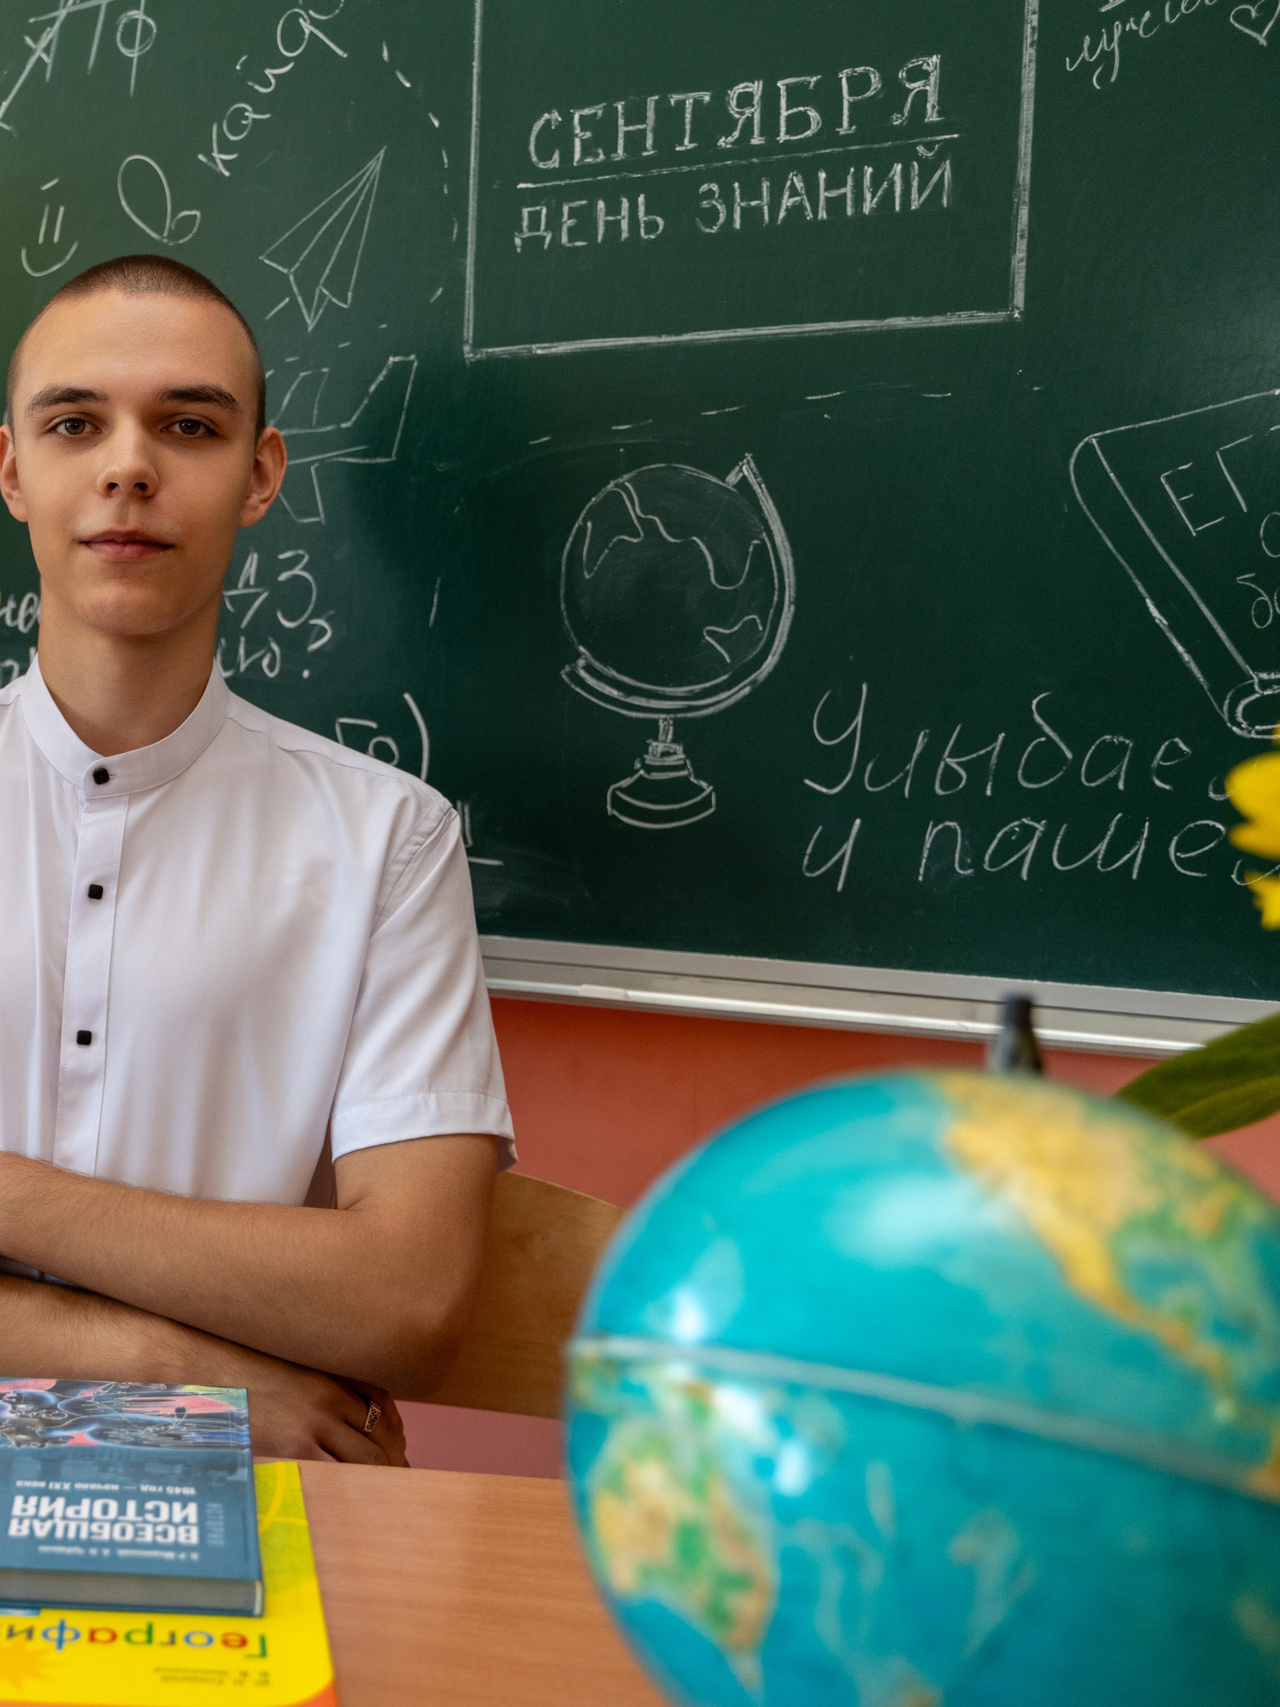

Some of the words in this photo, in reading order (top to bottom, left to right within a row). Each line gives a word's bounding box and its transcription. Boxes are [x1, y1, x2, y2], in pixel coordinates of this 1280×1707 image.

[527, 54, 942, 169] СЕНТЯБРЯ
[514, 193, 665, 253] ДЕНЬ
[694, 142, 953, 236] ЗНАНИЙ
[1160, 424, 1280, 537] ЕГ
[803, 681, 1234, 802] Улыбае
[802, 817, 862, 892] и
[7, 1517, 200, 1546] ВСЕОБЩАЯ
[11, 1494, 199, 1525] ИСТОРИЯ
